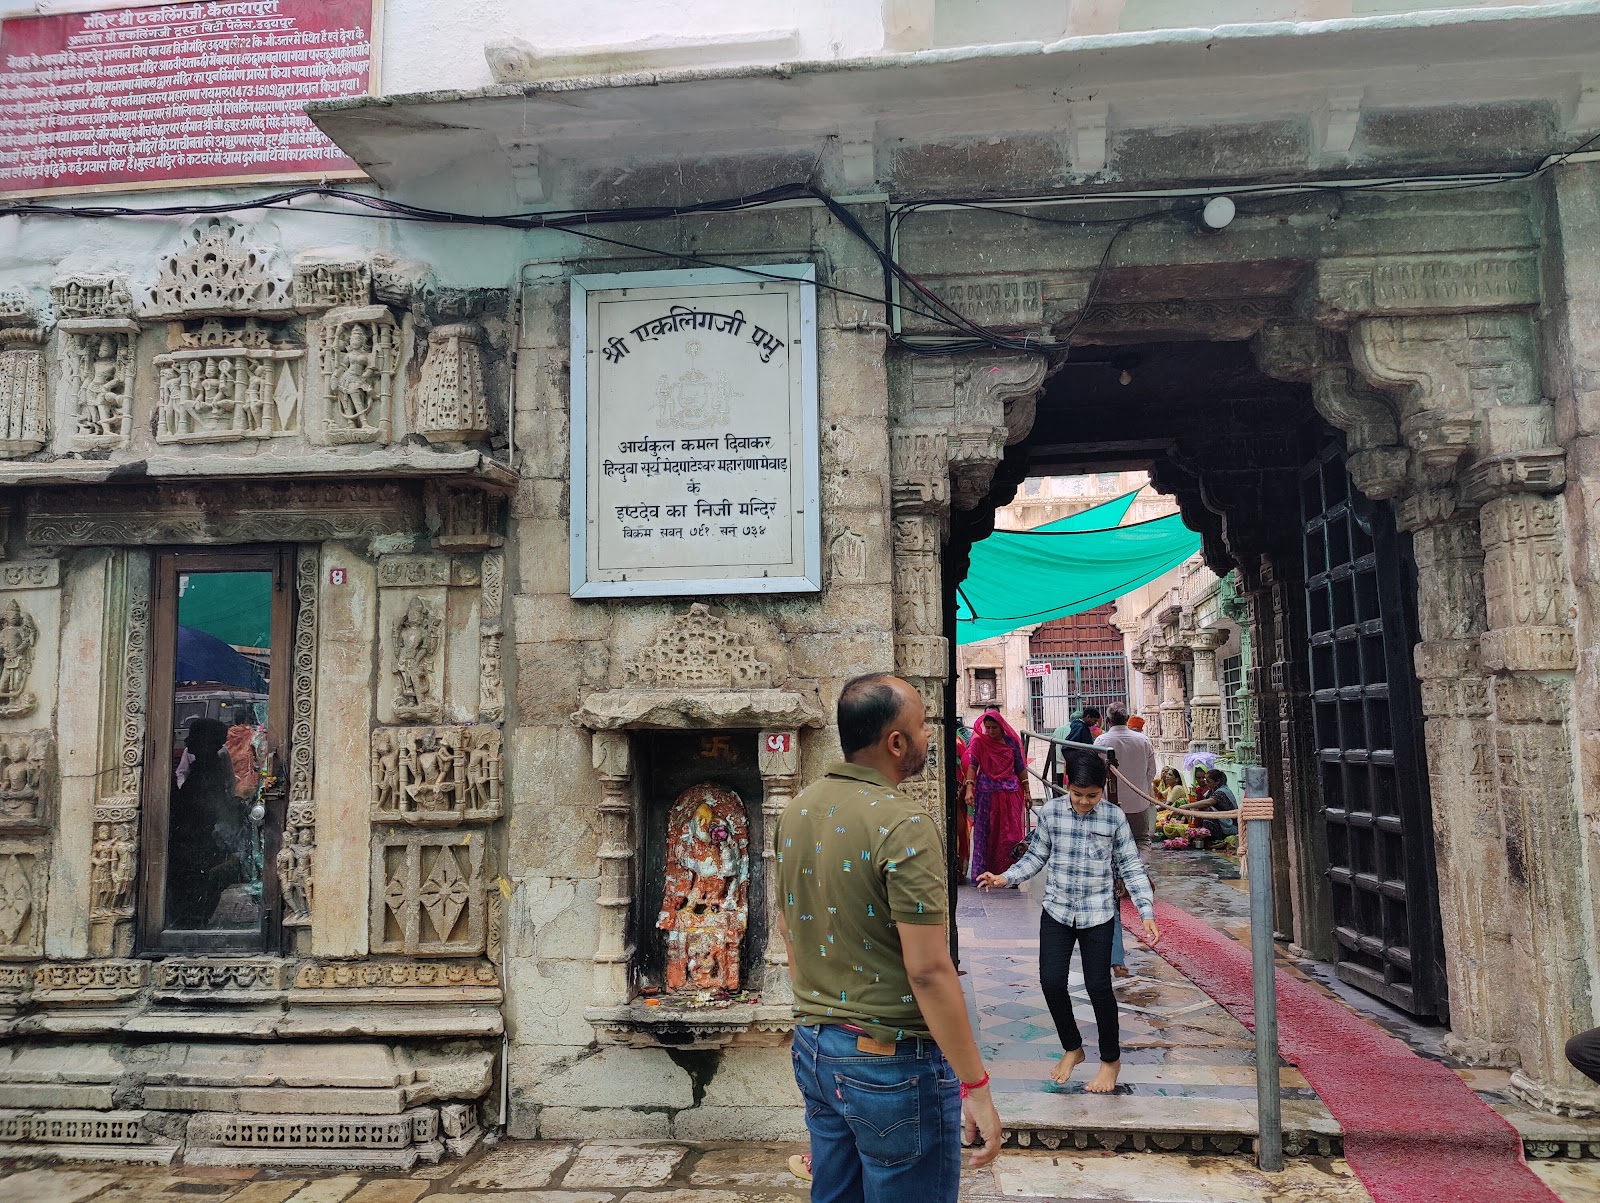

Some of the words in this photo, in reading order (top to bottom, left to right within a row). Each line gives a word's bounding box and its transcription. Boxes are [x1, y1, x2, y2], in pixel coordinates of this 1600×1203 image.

[83, 12, 117, 29] मंदिर
[118, 9, 134, 26] श्री
[105, 30, 117, 43] श्री
[116, 26, 171, 41] एकलिंगजी
[201, 20, 225, 34] सिटी
[256, 18, 296, 30] उदयपुर
[104, 48, 130, 60] भगवान
[131, 45, 148, 57] शिव
[149, 46, 160, 56] का
[160, 44, 172, 55] यह
[173, 41, 189, 53] निजी
[188, 39, 207, 52] मंदिर
[302, 31, 320, 44] स्थित
[328, 30, 339, 42] एवं
[340, 28, 355, 42] देश
[355, 26, 365, 39] के
[127, 63, 139, 74] यह
[140, 59, 158, 73] मंदिर
[291, 50, 308, 61] गया
[72, 84, 86, 94] कर
[134, 76, 157, 88] मोकल
[173, 71, 193, 85] मंदिर
[193, 72, 205, 82] का
[270, 65, 291, 78] किया
[60, 99, 90, 111] अनुसार
[90, 95, 109, 108] मंदिर
[110, 97, 122, 107] का
[122, 92, 147, 106] वर्तमान
[168, 89, 200, 102] महाराणा
[295, 82, 319, 94] प्रदान
[320, 76, 340, 92] किया
[48, 114, 67, 127] स्थित
[254, 96, 287, 112] महाराणा
[180, 118, 204, 132] वर्तमान
[204, 132, 215, 147] को
[82, 161, 108, 172] प्रयास
[109, 157, 126, 170] किए
[157, 153, 177, 169] मंदिर
[177, 151, 186, 165] के
[222, 147, 243, 164] आम
[603, 337, 630, 364] श्री
[630, 305, 746, 343] एकलिंगजी
[747, 324, 785, 363] प्रभु
[618, 435, 676, 456] आर्यकुल
[681, 438, 719, 451] कमल
[724, 434, 772, 453] दिवाकर
[603, 460, 638, 482] हिन्दुवा
[641, 457, 662, 477] सूर्य
[662, 457, 716, 476] मेदपाटेश्वर
[687, 478, 701, 494] के
[615, 502, 660, 522] इष्टदेव
[666, 505, 688, 517] का
[694, 499, 732, 517] निजी
[738, 498, 777, 519] मन्दिर
[622, 527, 653, 538] विक्रम
[720, 526, 736, 538] सन्
[743, 526, 767, 538] ७३४
